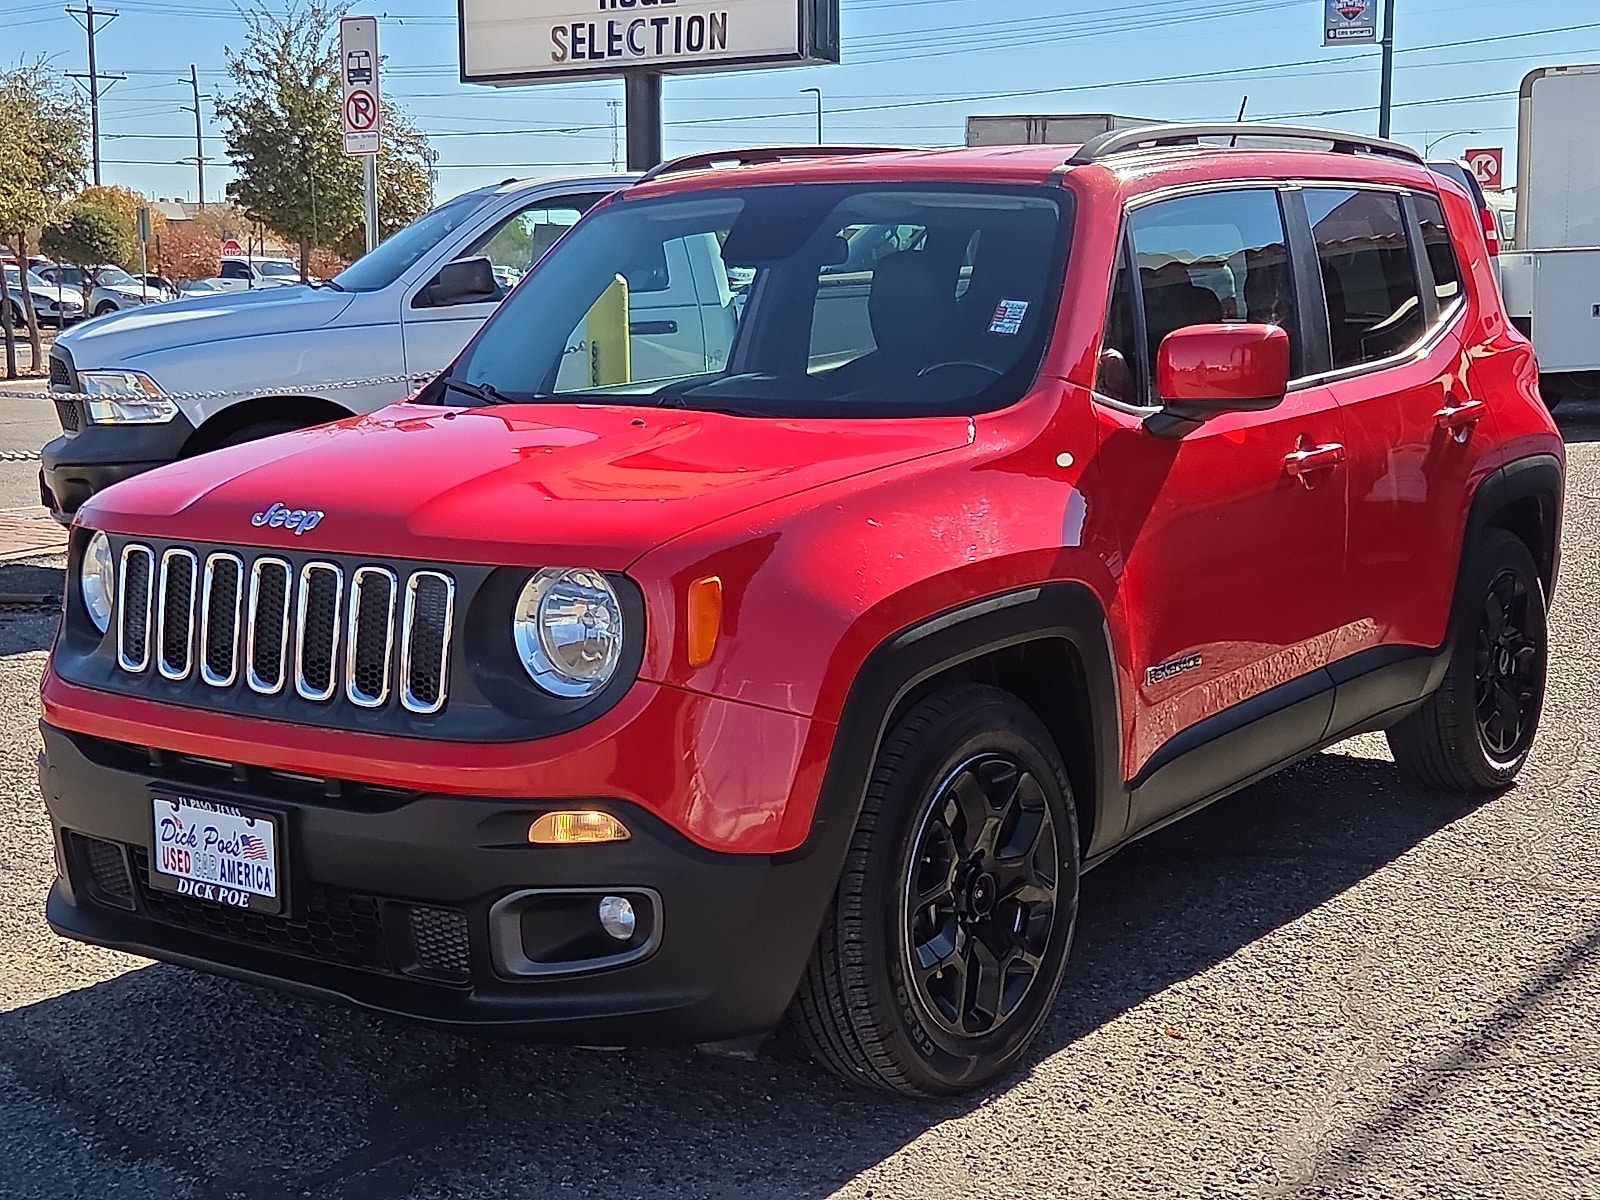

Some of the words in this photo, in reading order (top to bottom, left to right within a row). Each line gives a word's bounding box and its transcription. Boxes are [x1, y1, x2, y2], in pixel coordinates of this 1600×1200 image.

[551, 12, 728, 62] SELECTION
[1477, 160, 1493, 176] K
[252, 502, 325, 536] Jeep
[160, 818, 198, 848] Dick
[203, 826, 241, 857] Poe's
[162, 846, 191, 874] USED
[193, 851, 218, 881] CAR
[219, 857, 272, 893] AMERICA
[177, 878, 216, 901] DICK
[218, 888, 250, 908] POE
